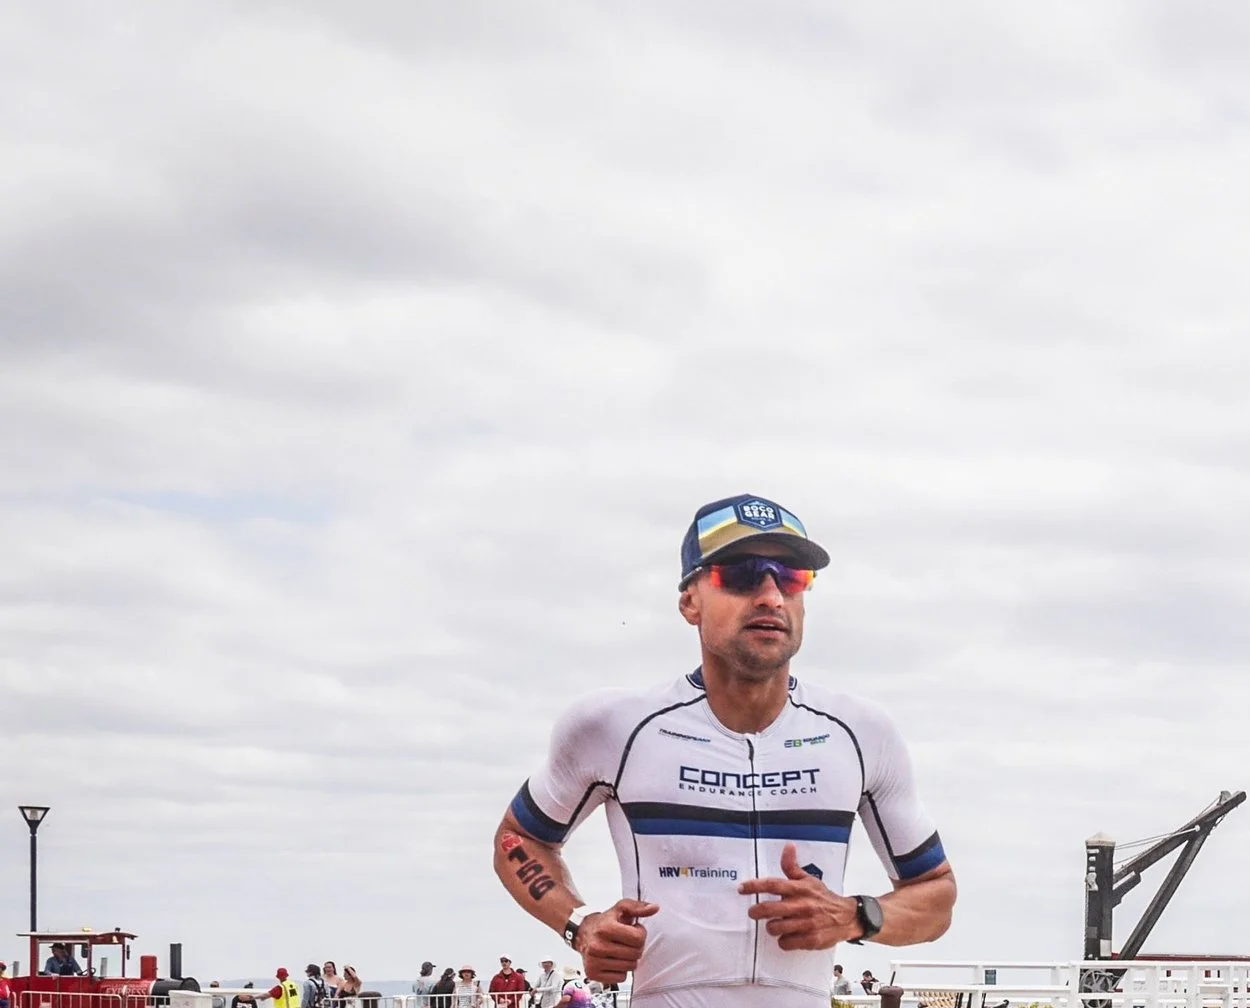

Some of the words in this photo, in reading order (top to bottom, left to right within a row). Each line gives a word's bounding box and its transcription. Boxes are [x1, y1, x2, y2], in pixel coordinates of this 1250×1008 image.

[743, 505, 774, 514] BOCO
[744, 510, 775, 520] GEAR
[679, 765, 821, 789] CONCEPT
[678, 782, 763, 797] ENDURANCE
[770, 786, 818, 796] COACH
[658, 866, 738, 881] HRV4Training
